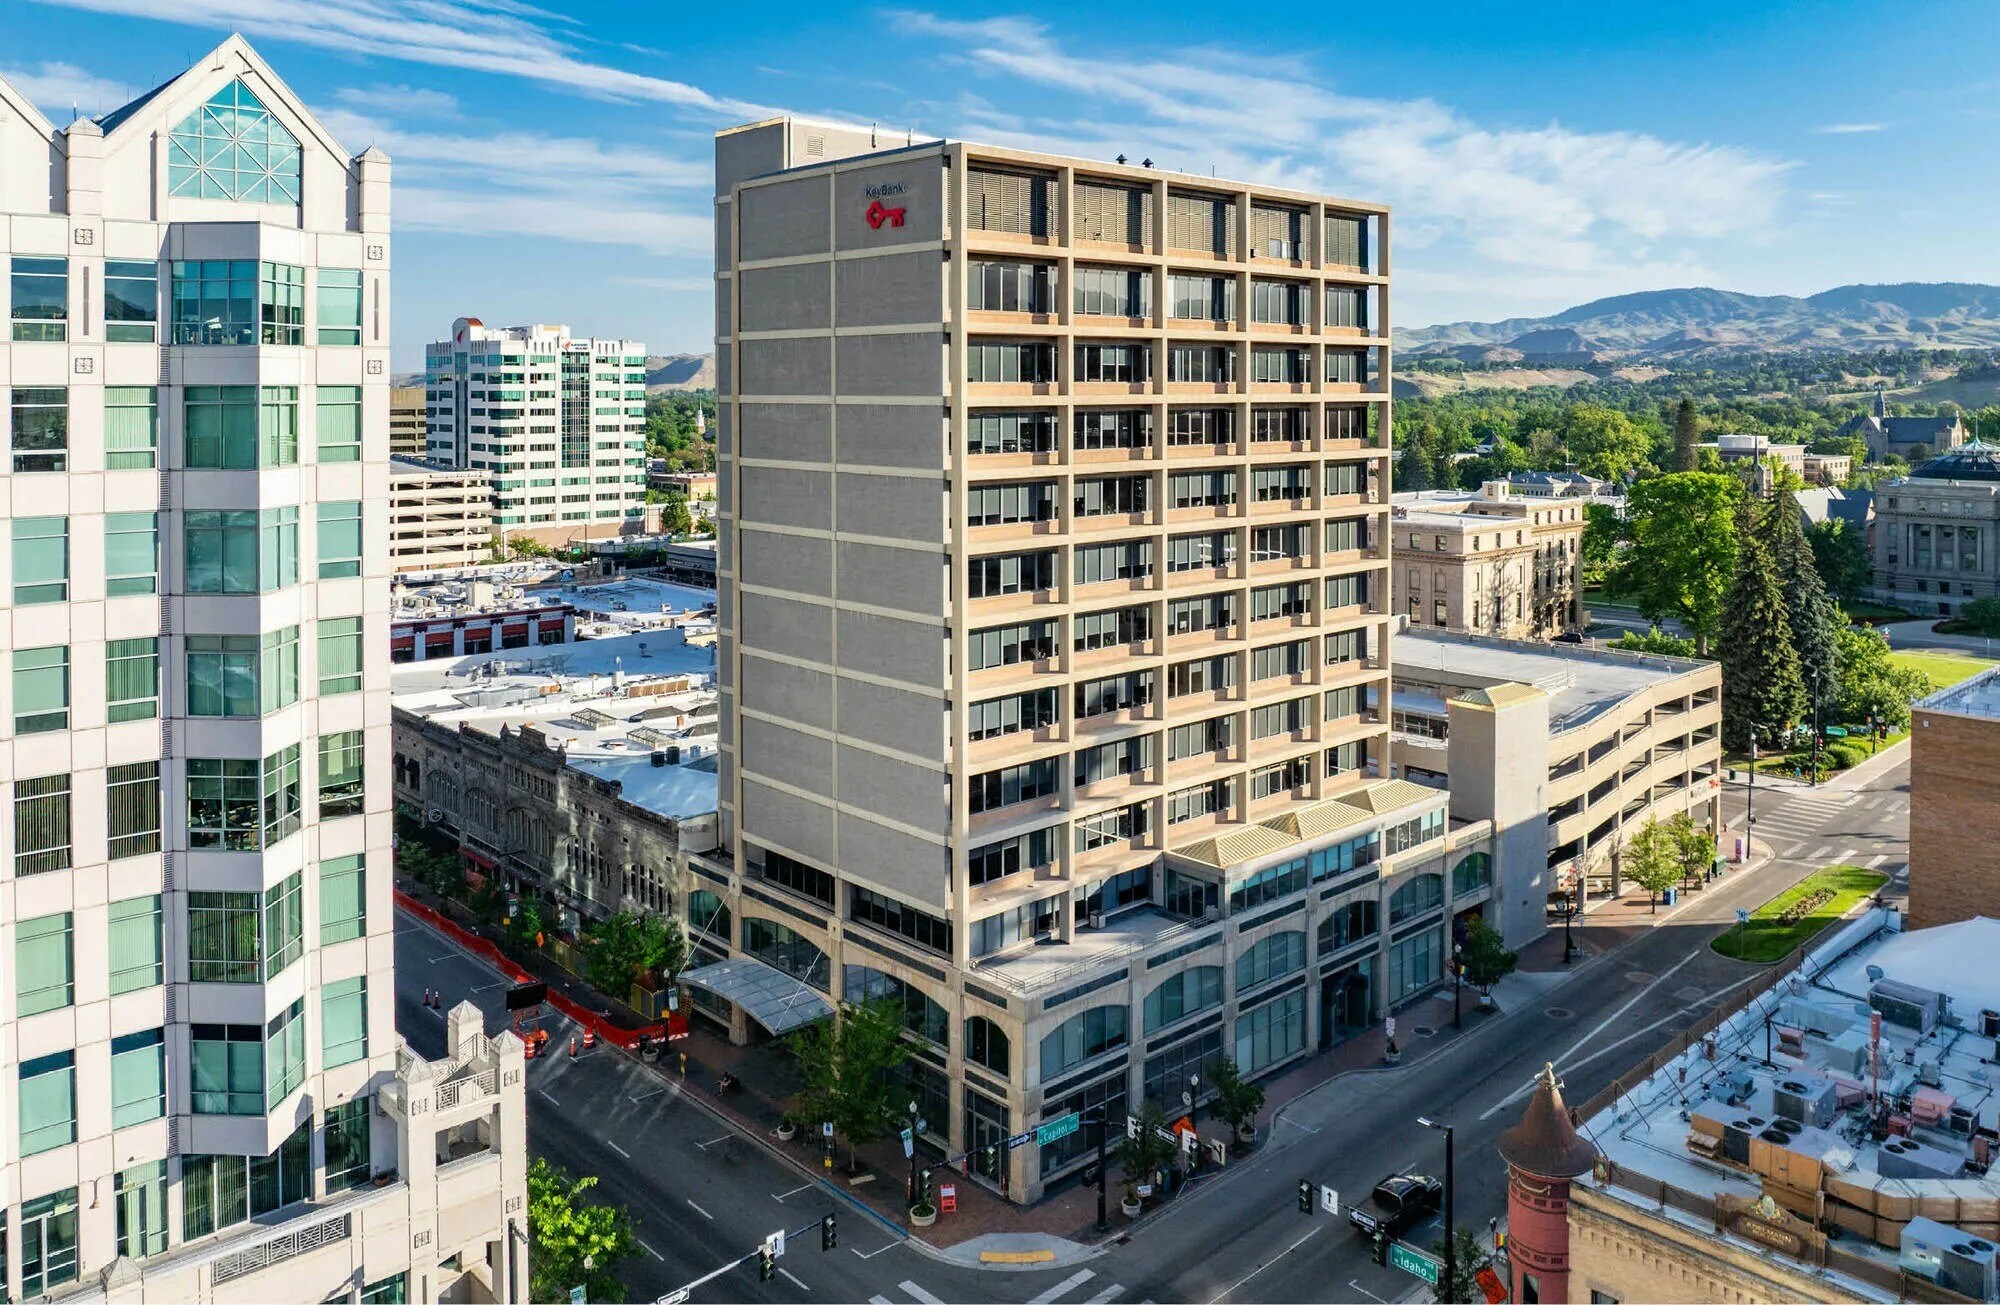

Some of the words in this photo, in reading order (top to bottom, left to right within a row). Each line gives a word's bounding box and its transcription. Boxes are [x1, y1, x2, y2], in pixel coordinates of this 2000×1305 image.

[865, 181, 907, 198] KeyBank
[1043, 1124, 1068, 1141] Capitol
[1400, 1256, 1427, 1277] Idaho
